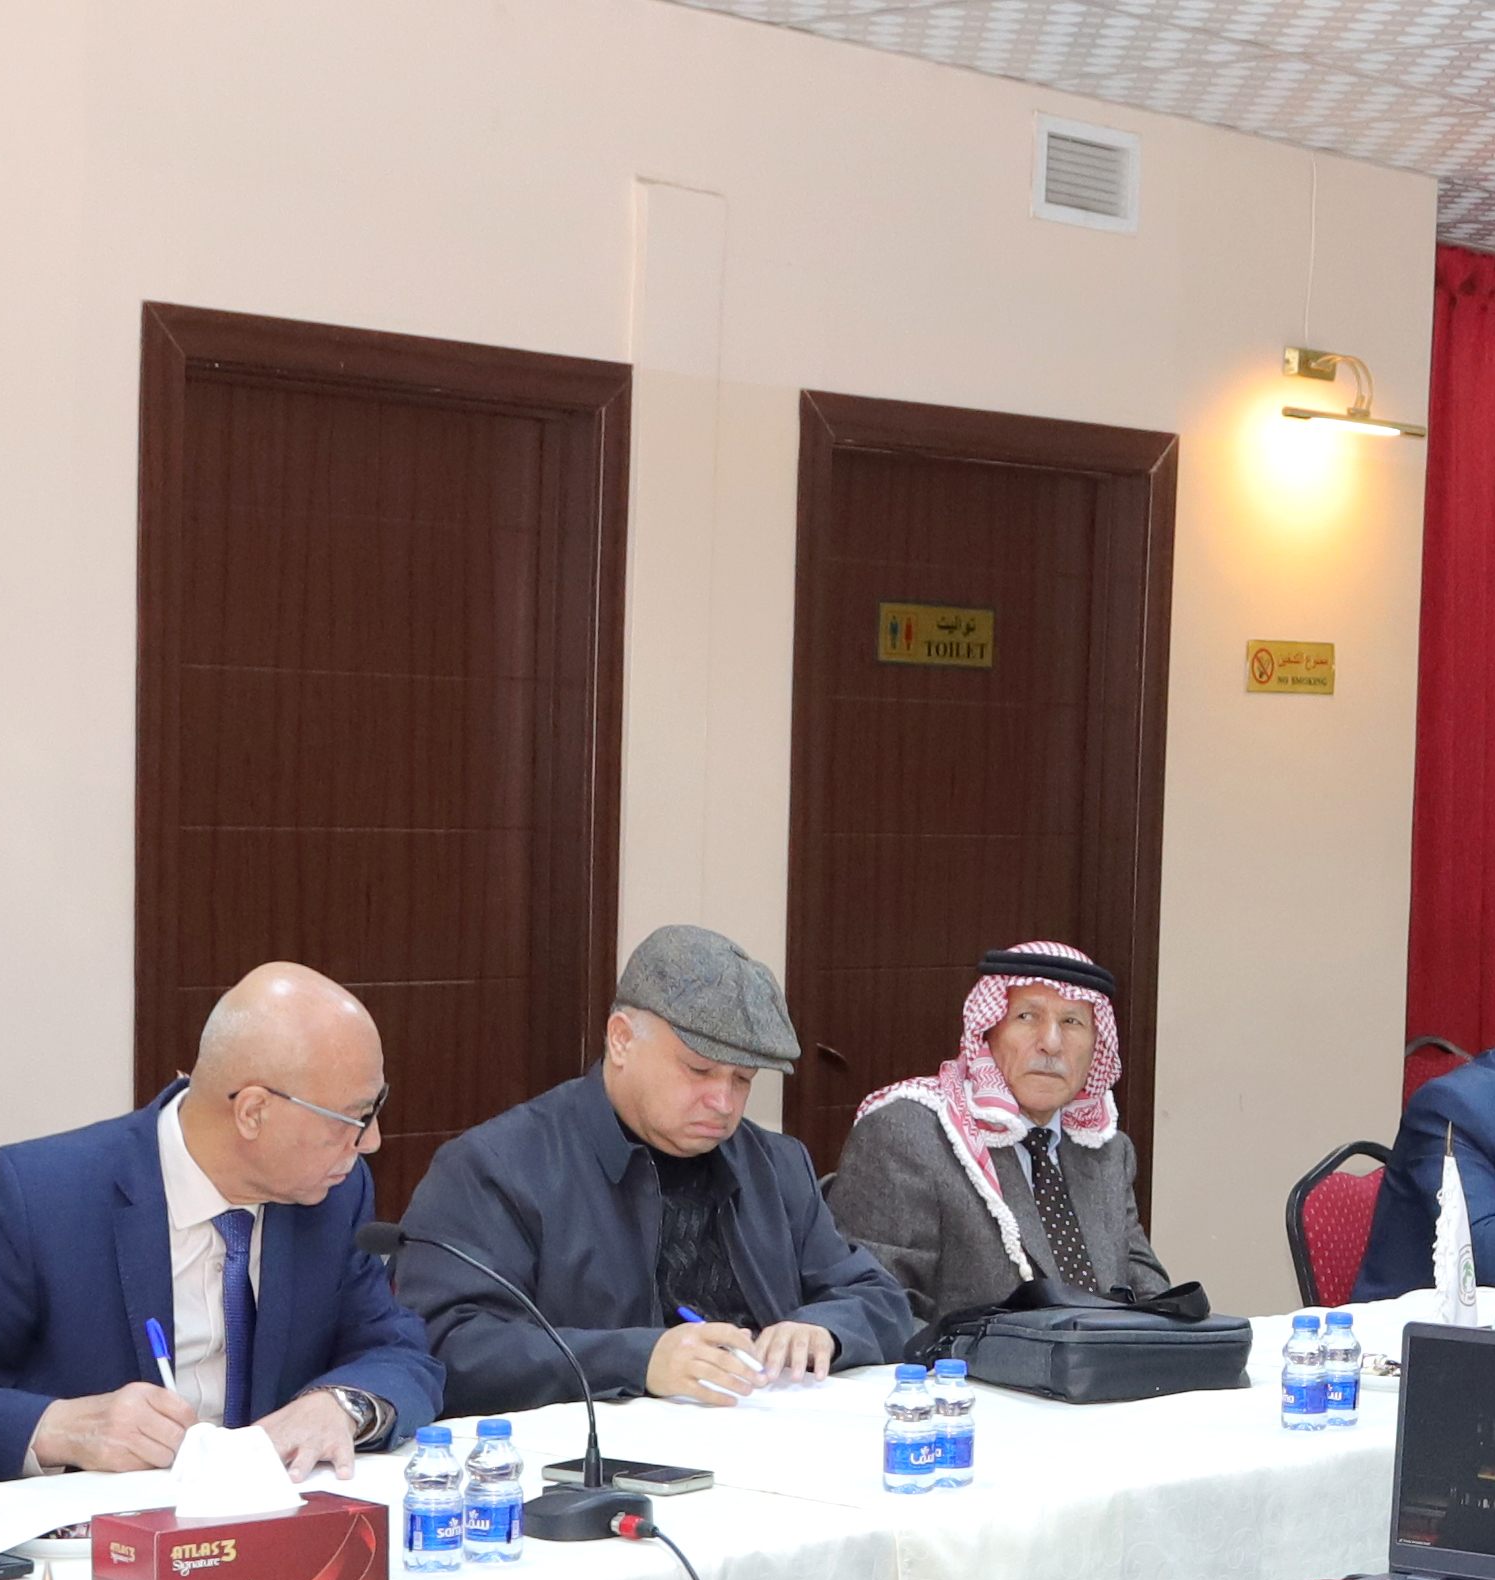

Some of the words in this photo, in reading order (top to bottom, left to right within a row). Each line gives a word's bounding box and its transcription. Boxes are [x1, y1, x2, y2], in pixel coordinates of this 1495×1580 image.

[925, 641, 987, 660] TOILET
[435, 1526, 464, 1539] sam
[170, 1541, 220, 1560] ATLAS
[220, 1539, 237, 1562] 3
[172, 1558, 221, 1577] Signature
